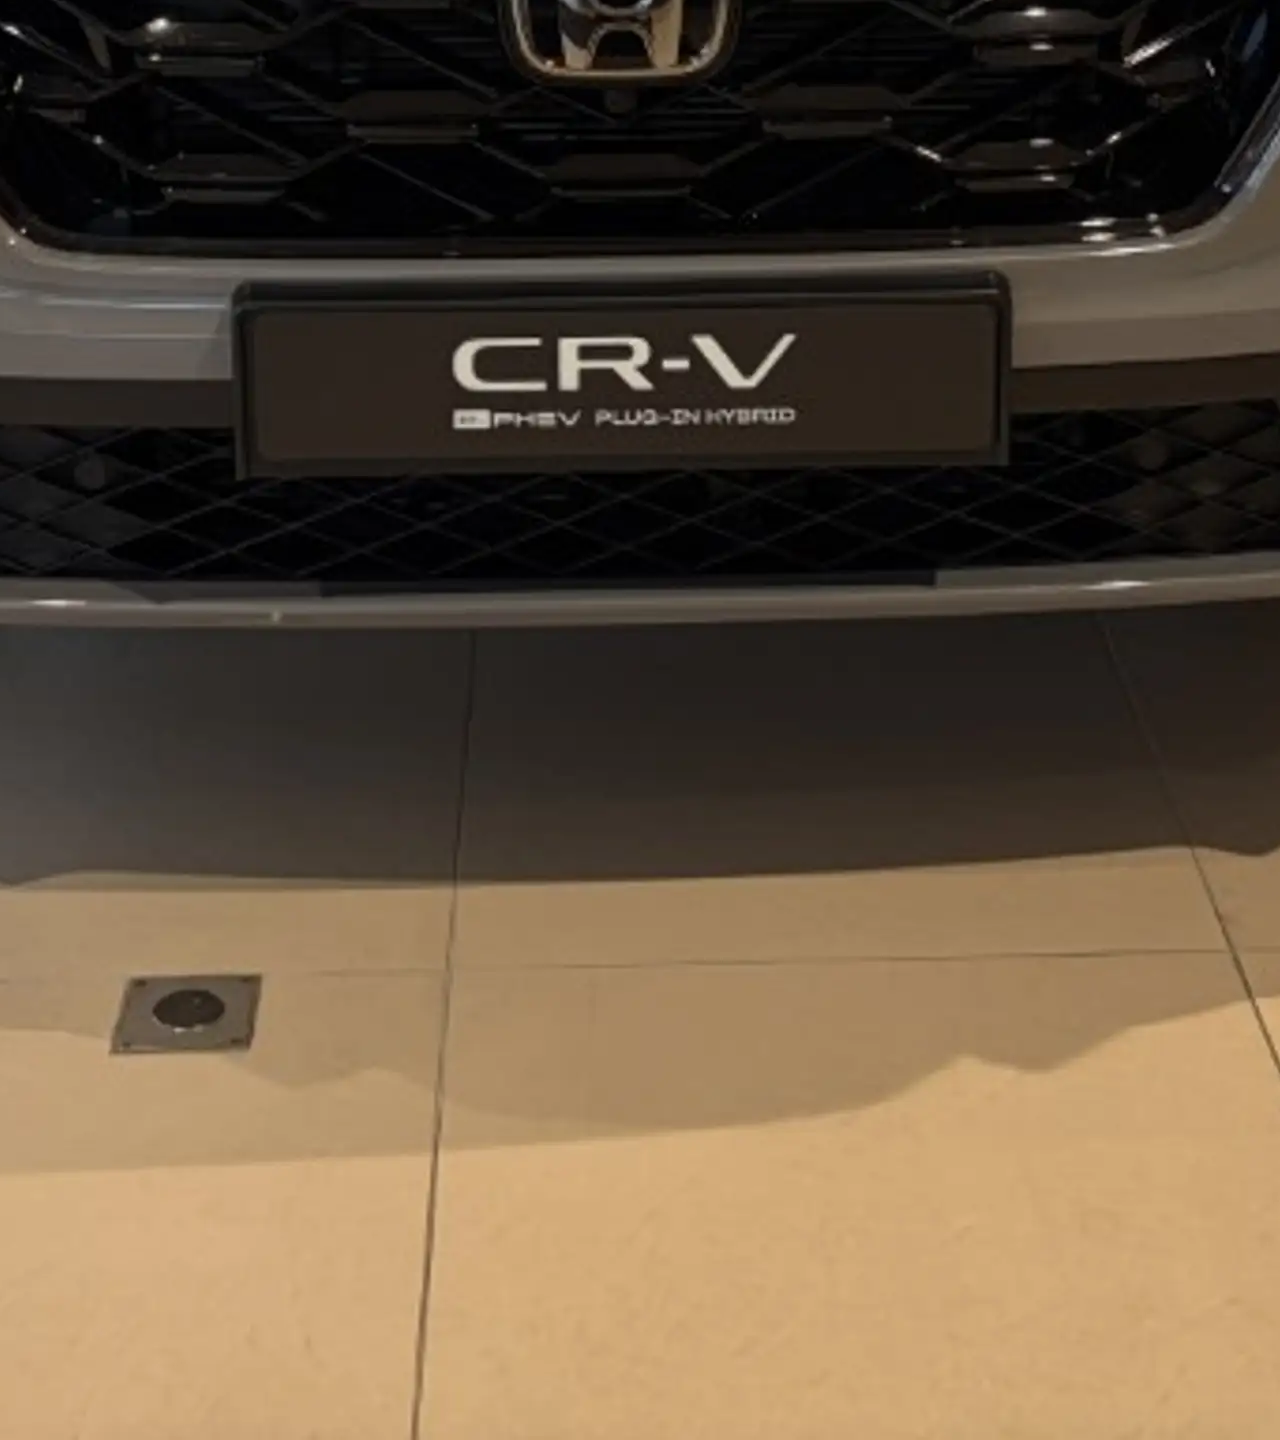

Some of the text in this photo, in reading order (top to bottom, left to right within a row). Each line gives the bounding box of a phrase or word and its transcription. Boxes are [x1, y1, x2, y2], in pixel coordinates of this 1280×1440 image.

[452, 333, 797, 391] CR-V
[595, 408, 701, 427] PLUG-IN
[704, 407, 796, 426] HYBRID
